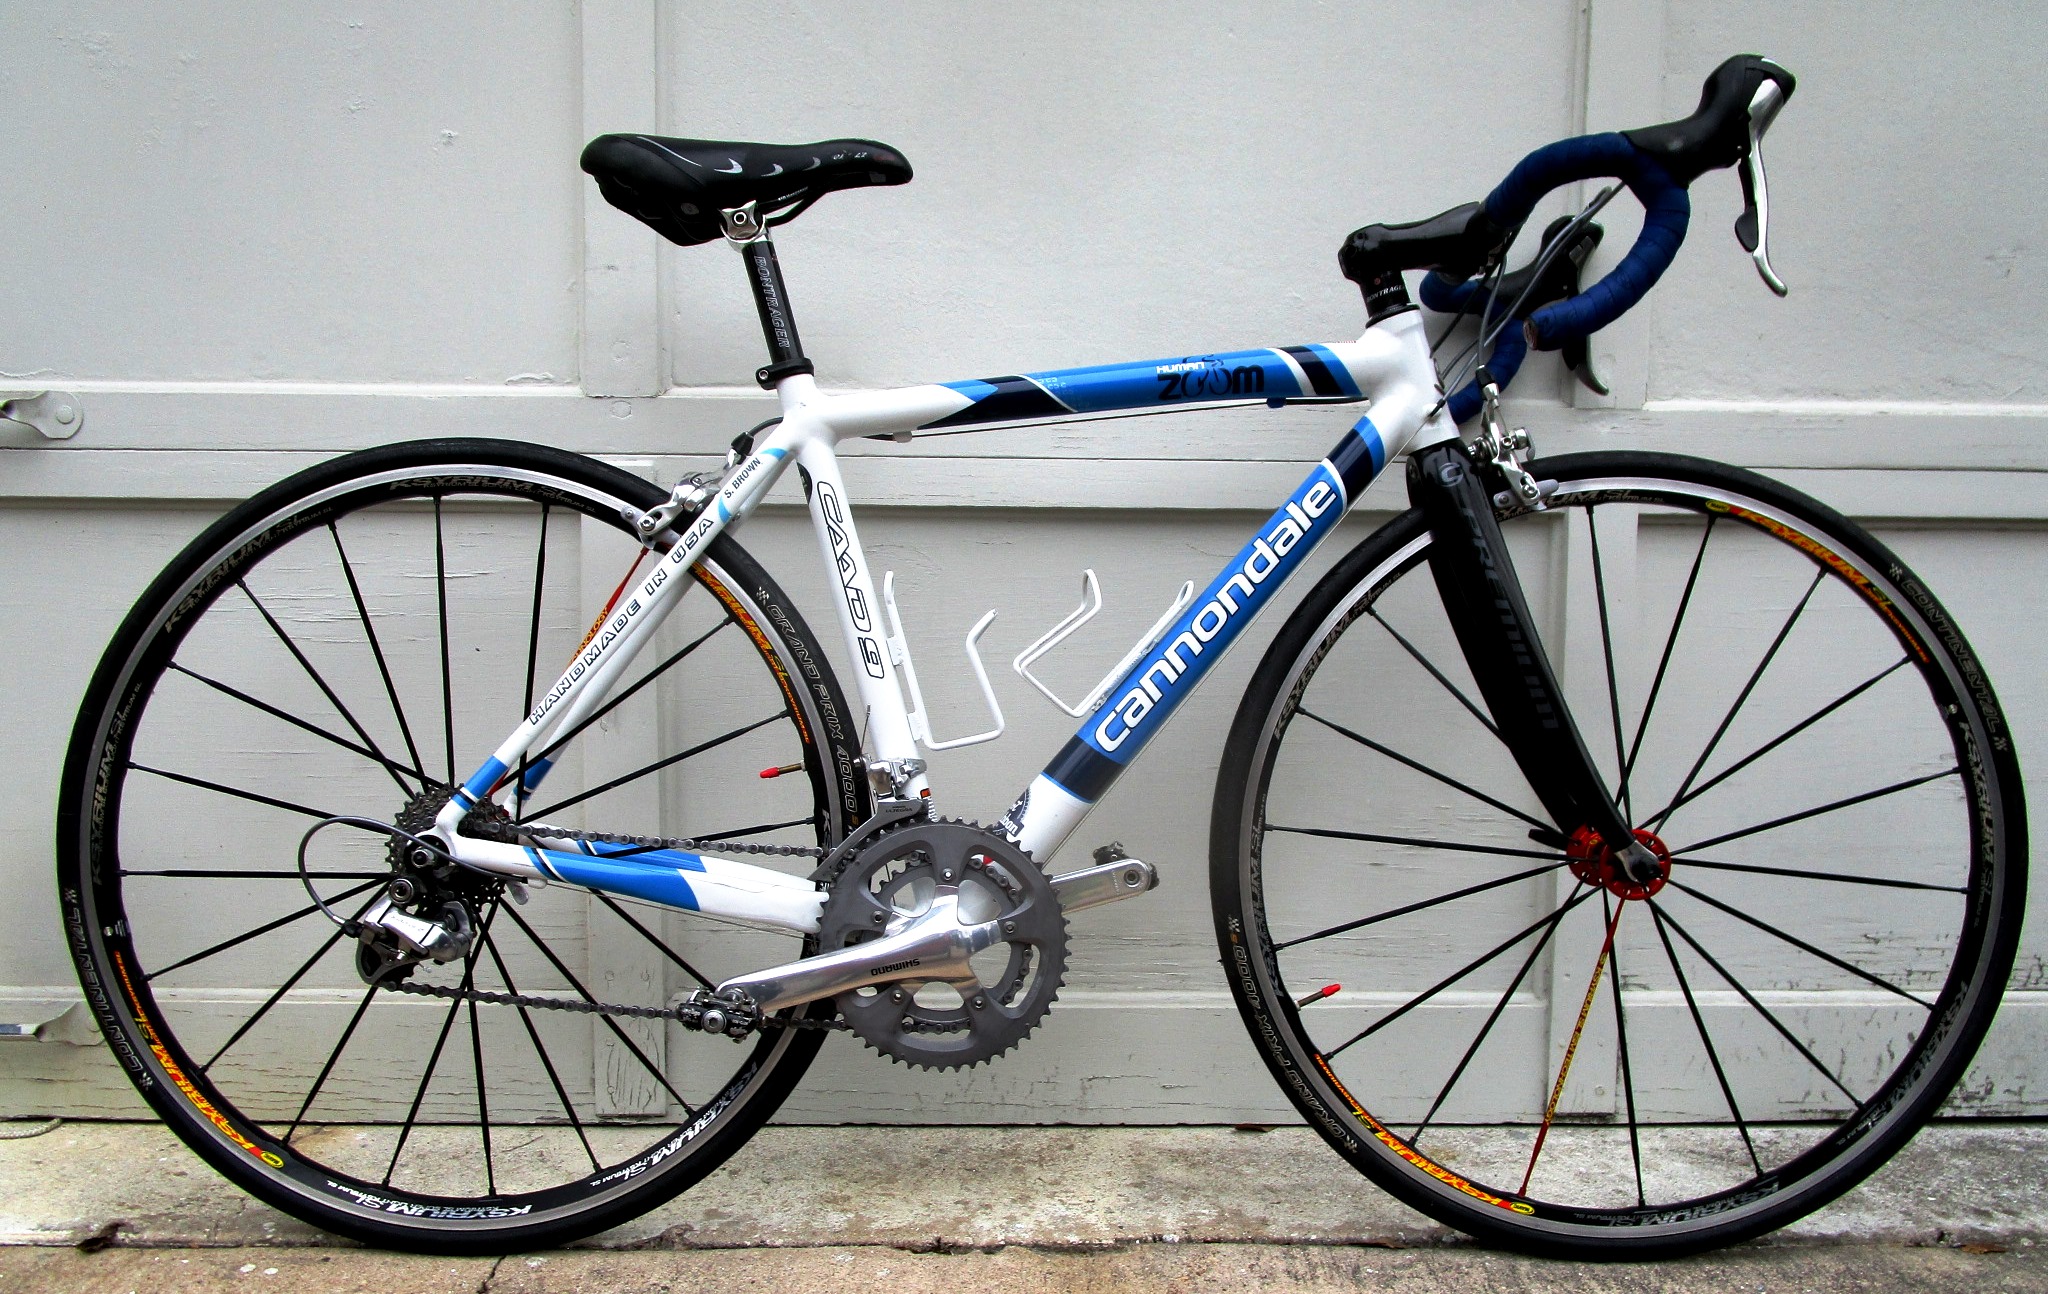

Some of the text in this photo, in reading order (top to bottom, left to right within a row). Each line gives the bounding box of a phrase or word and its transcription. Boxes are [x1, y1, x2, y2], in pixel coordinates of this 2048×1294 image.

[754, 256, 790, 348] BONTRAGER
[724, 457, 762, 500] S. BROWN
[529, 518, 714, 725] HANDMADE IN USA
[689, 563, 774, 652] SYRIUM
[1094, 480, 1337, 754] cannondale
[765, 606, 820, 678] GRAND
[812, 685, 844, 738] PRIX
[1899, 582, 2002, 732] CONTINENTAL
[66, 907, 144, 1070] CONTINENTAL
[871, 957, 921, 977] SHIMANO
[1254, 1015, 1291, 1063] PRIX
[148, 1043, 256, 1149] KSYRIUM
[1283, 1069, 1347, 1136] GRAND
[384, 1200, 531, 1218] KSYRIUM
[1373, 1128, 1503, 1205] KSYRIUM
